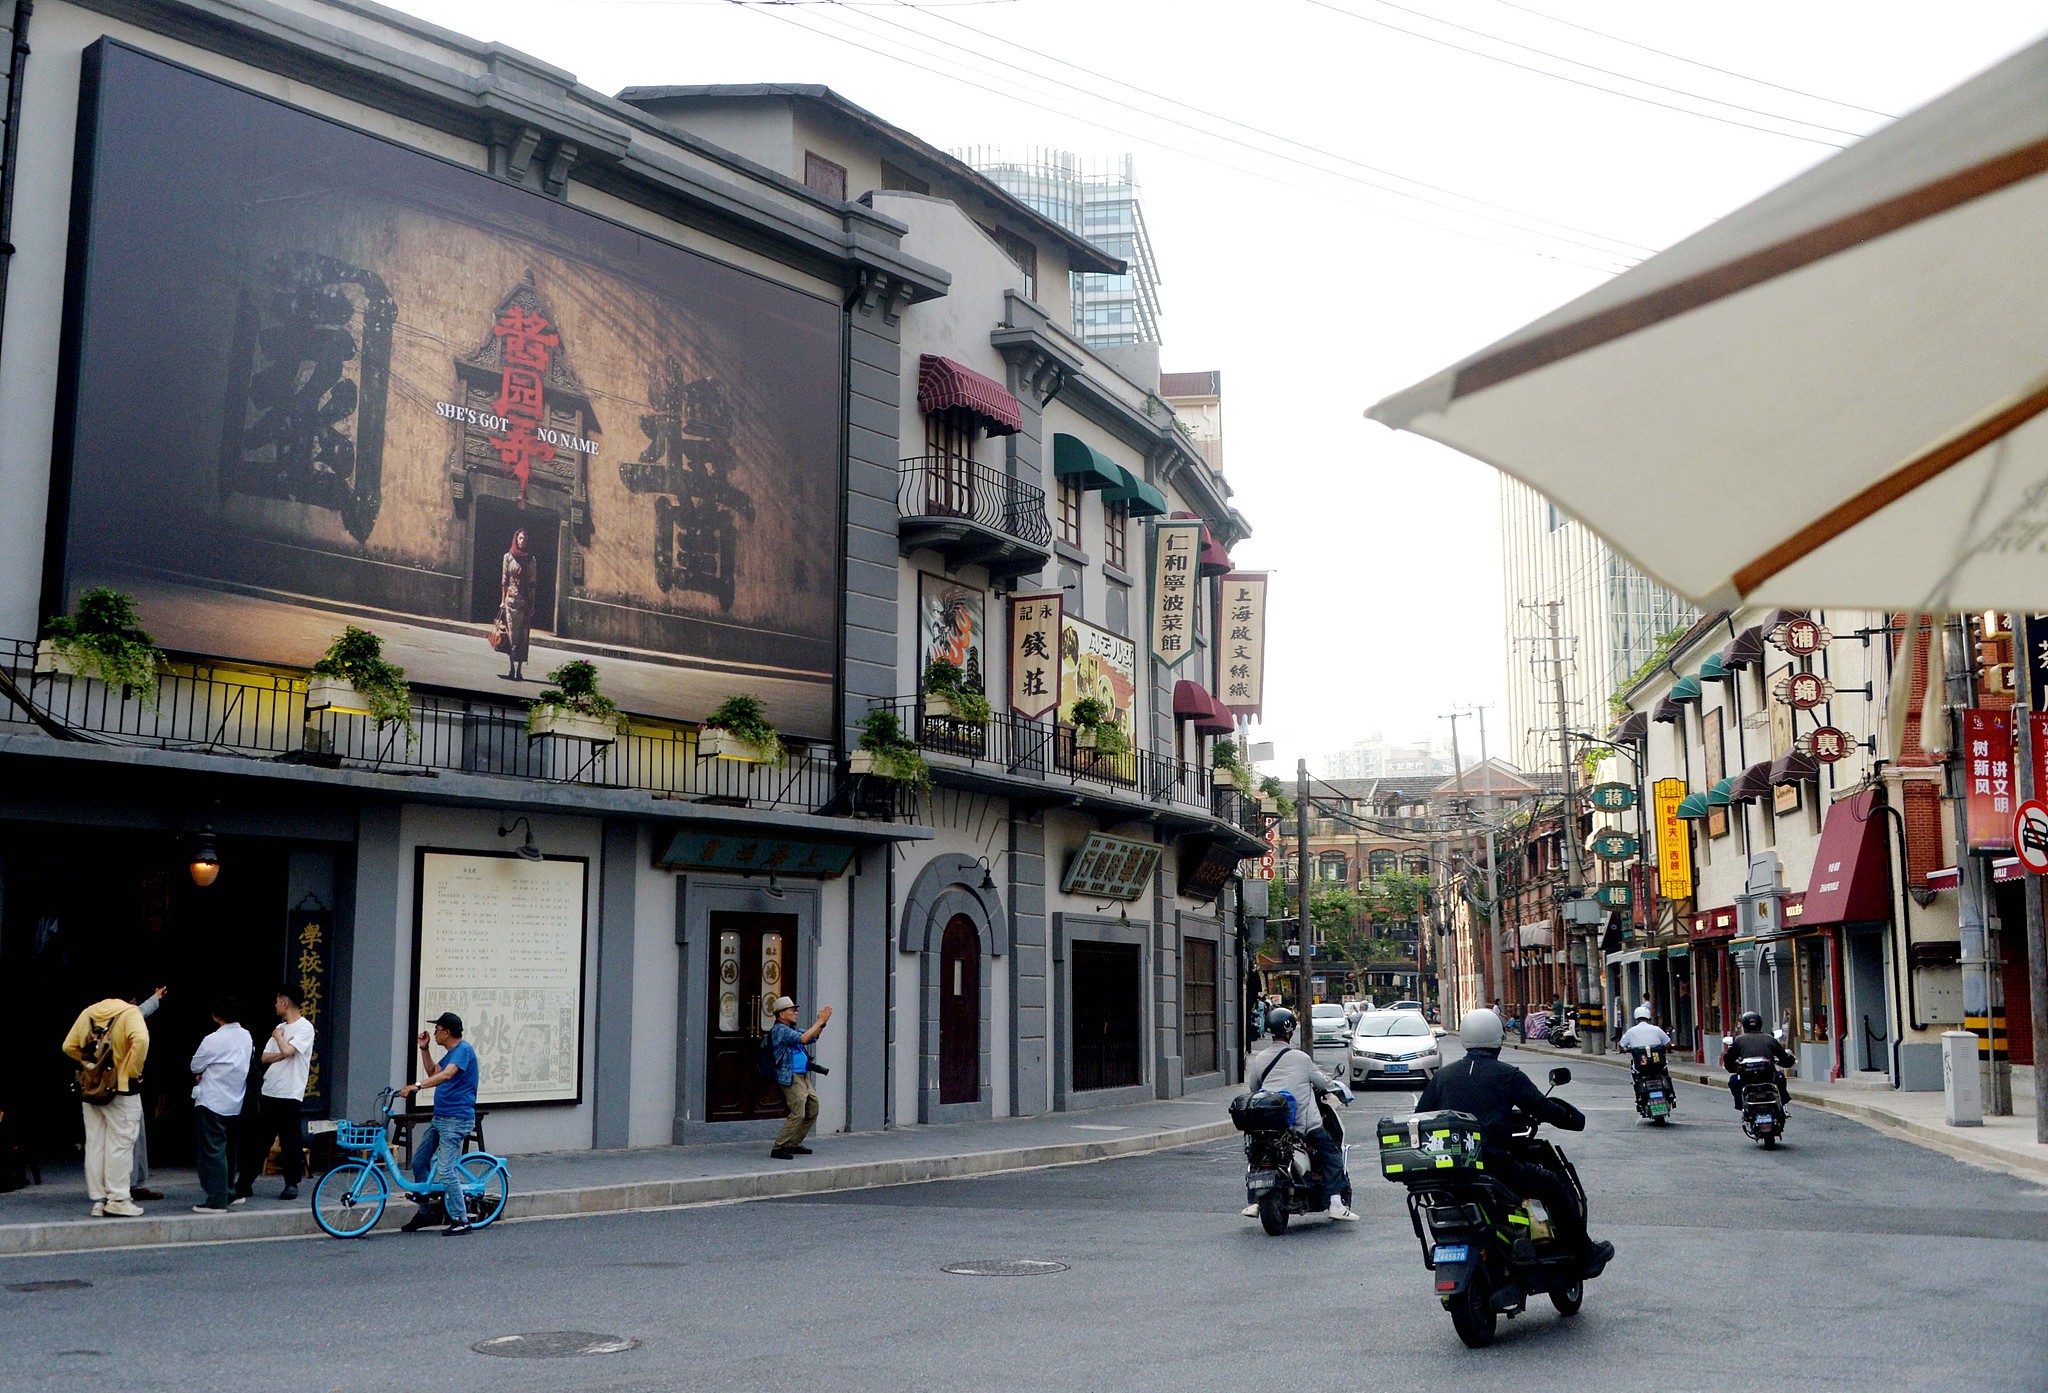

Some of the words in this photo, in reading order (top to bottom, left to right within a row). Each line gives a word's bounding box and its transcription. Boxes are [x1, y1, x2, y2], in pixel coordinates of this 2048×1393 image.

[436, 401, 477, 424] SHE'S
[479, 412, 509, 432] GOT
[537, 427, 557, 445] NO
[560, 433, 599, 455] NAME
[1161, 533, 1189, 652] 仁和寧波菜館
[1973, 740, 1990, 795] 树新风
[1992, 761, 2009, 813] 讲文明
